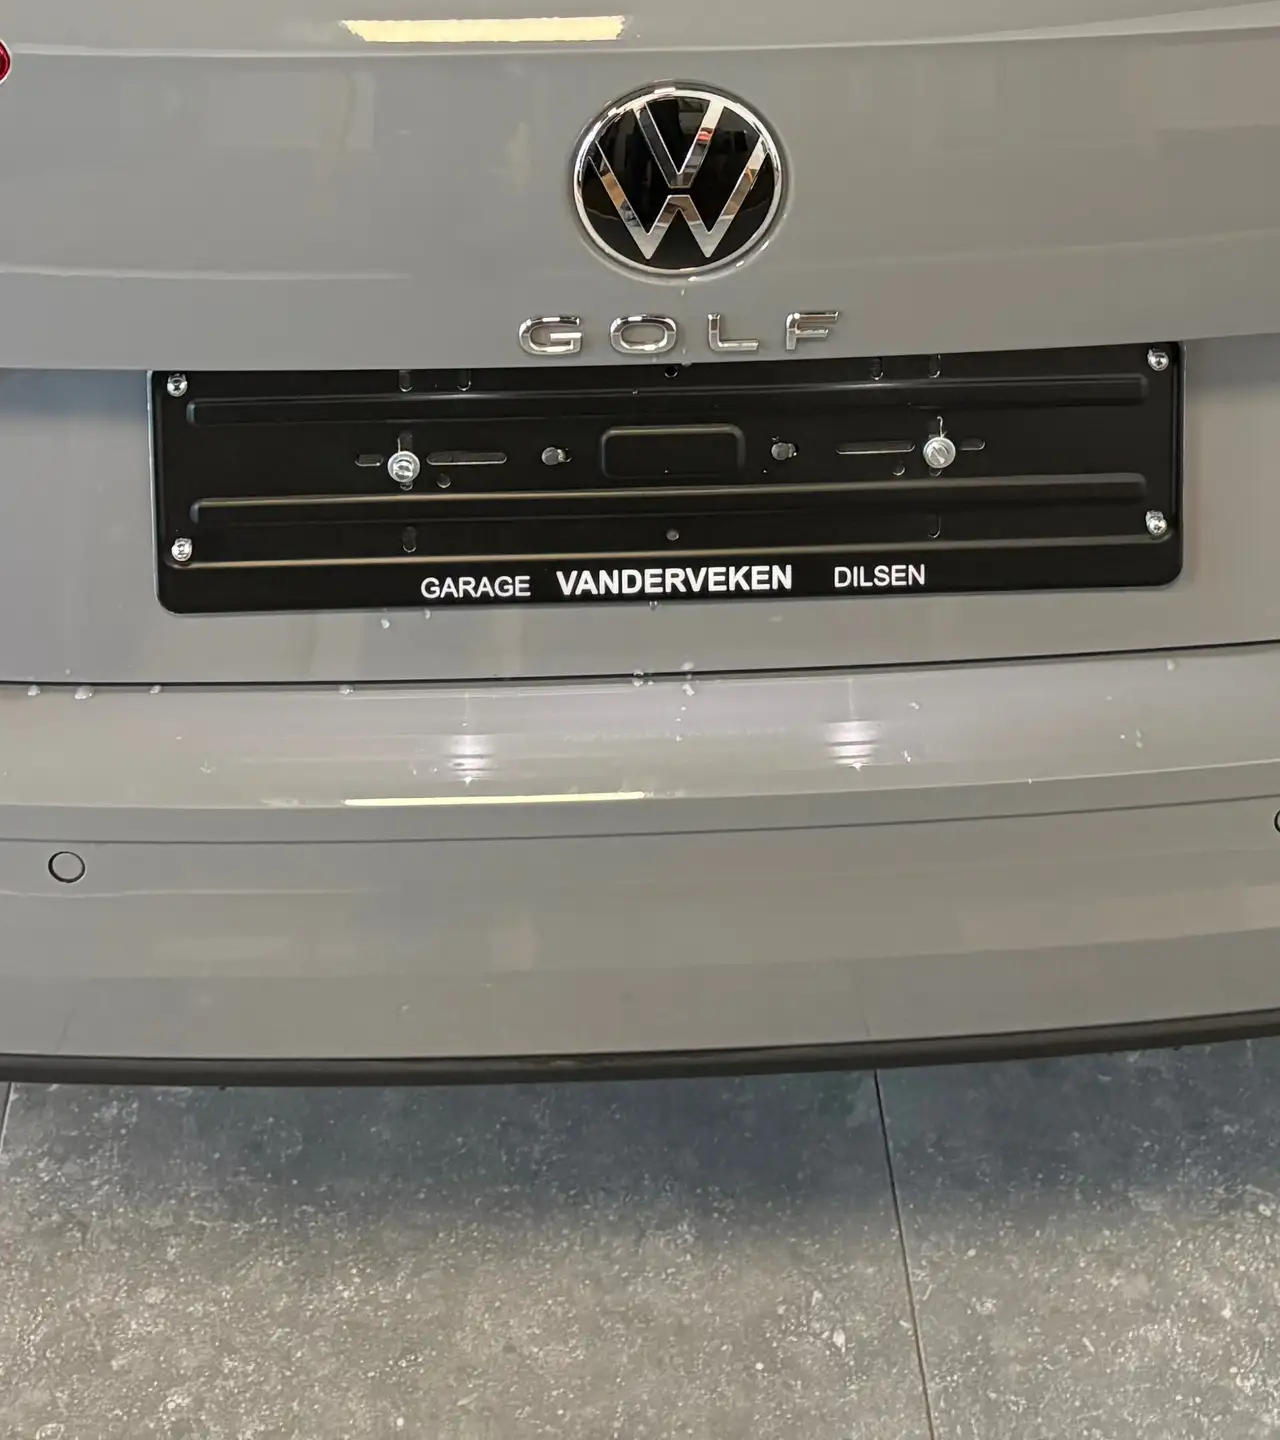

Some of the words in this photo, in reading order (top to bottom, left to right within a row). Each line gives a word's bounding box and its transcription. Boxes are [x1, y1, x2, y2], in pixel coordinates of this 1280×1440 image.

[518, 311, 840, 356] GOLF
[420, 575, 532, 599] GARAGE
[556, 564, 793, 596] VANDERVEKEN
[833, 563, 927, 589] DILSEN
